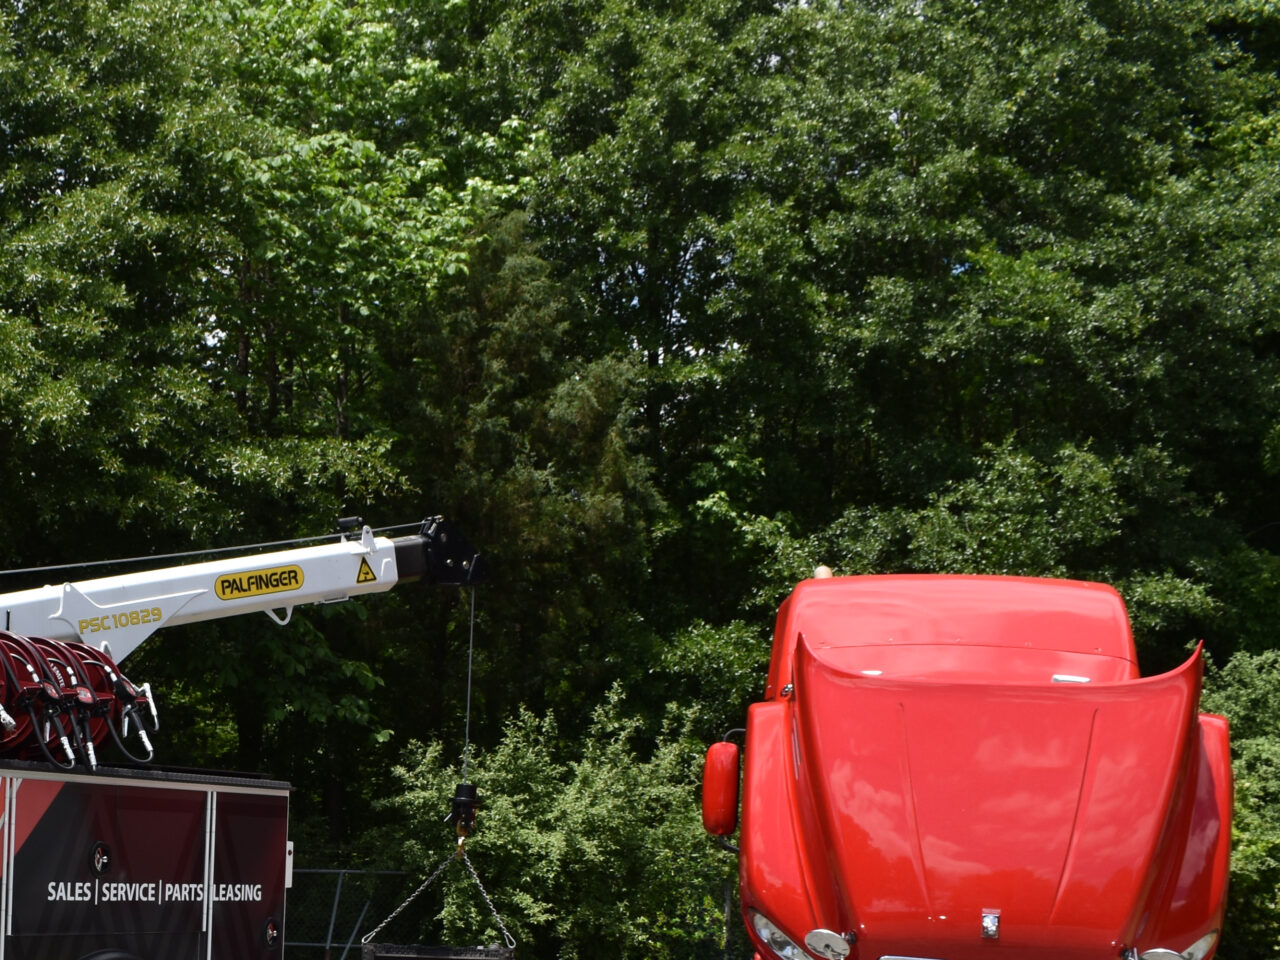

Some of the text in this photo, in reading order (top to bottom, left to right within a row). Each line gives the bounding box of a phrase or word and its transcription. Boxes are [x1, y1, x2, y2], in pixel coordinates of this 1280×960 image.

[221, 569, 299, 596] PALFINGER
[78, 607, 163, 635] PSC10829
[47, 881, 262, 902] SALES SERVICE PARTS LEASING
